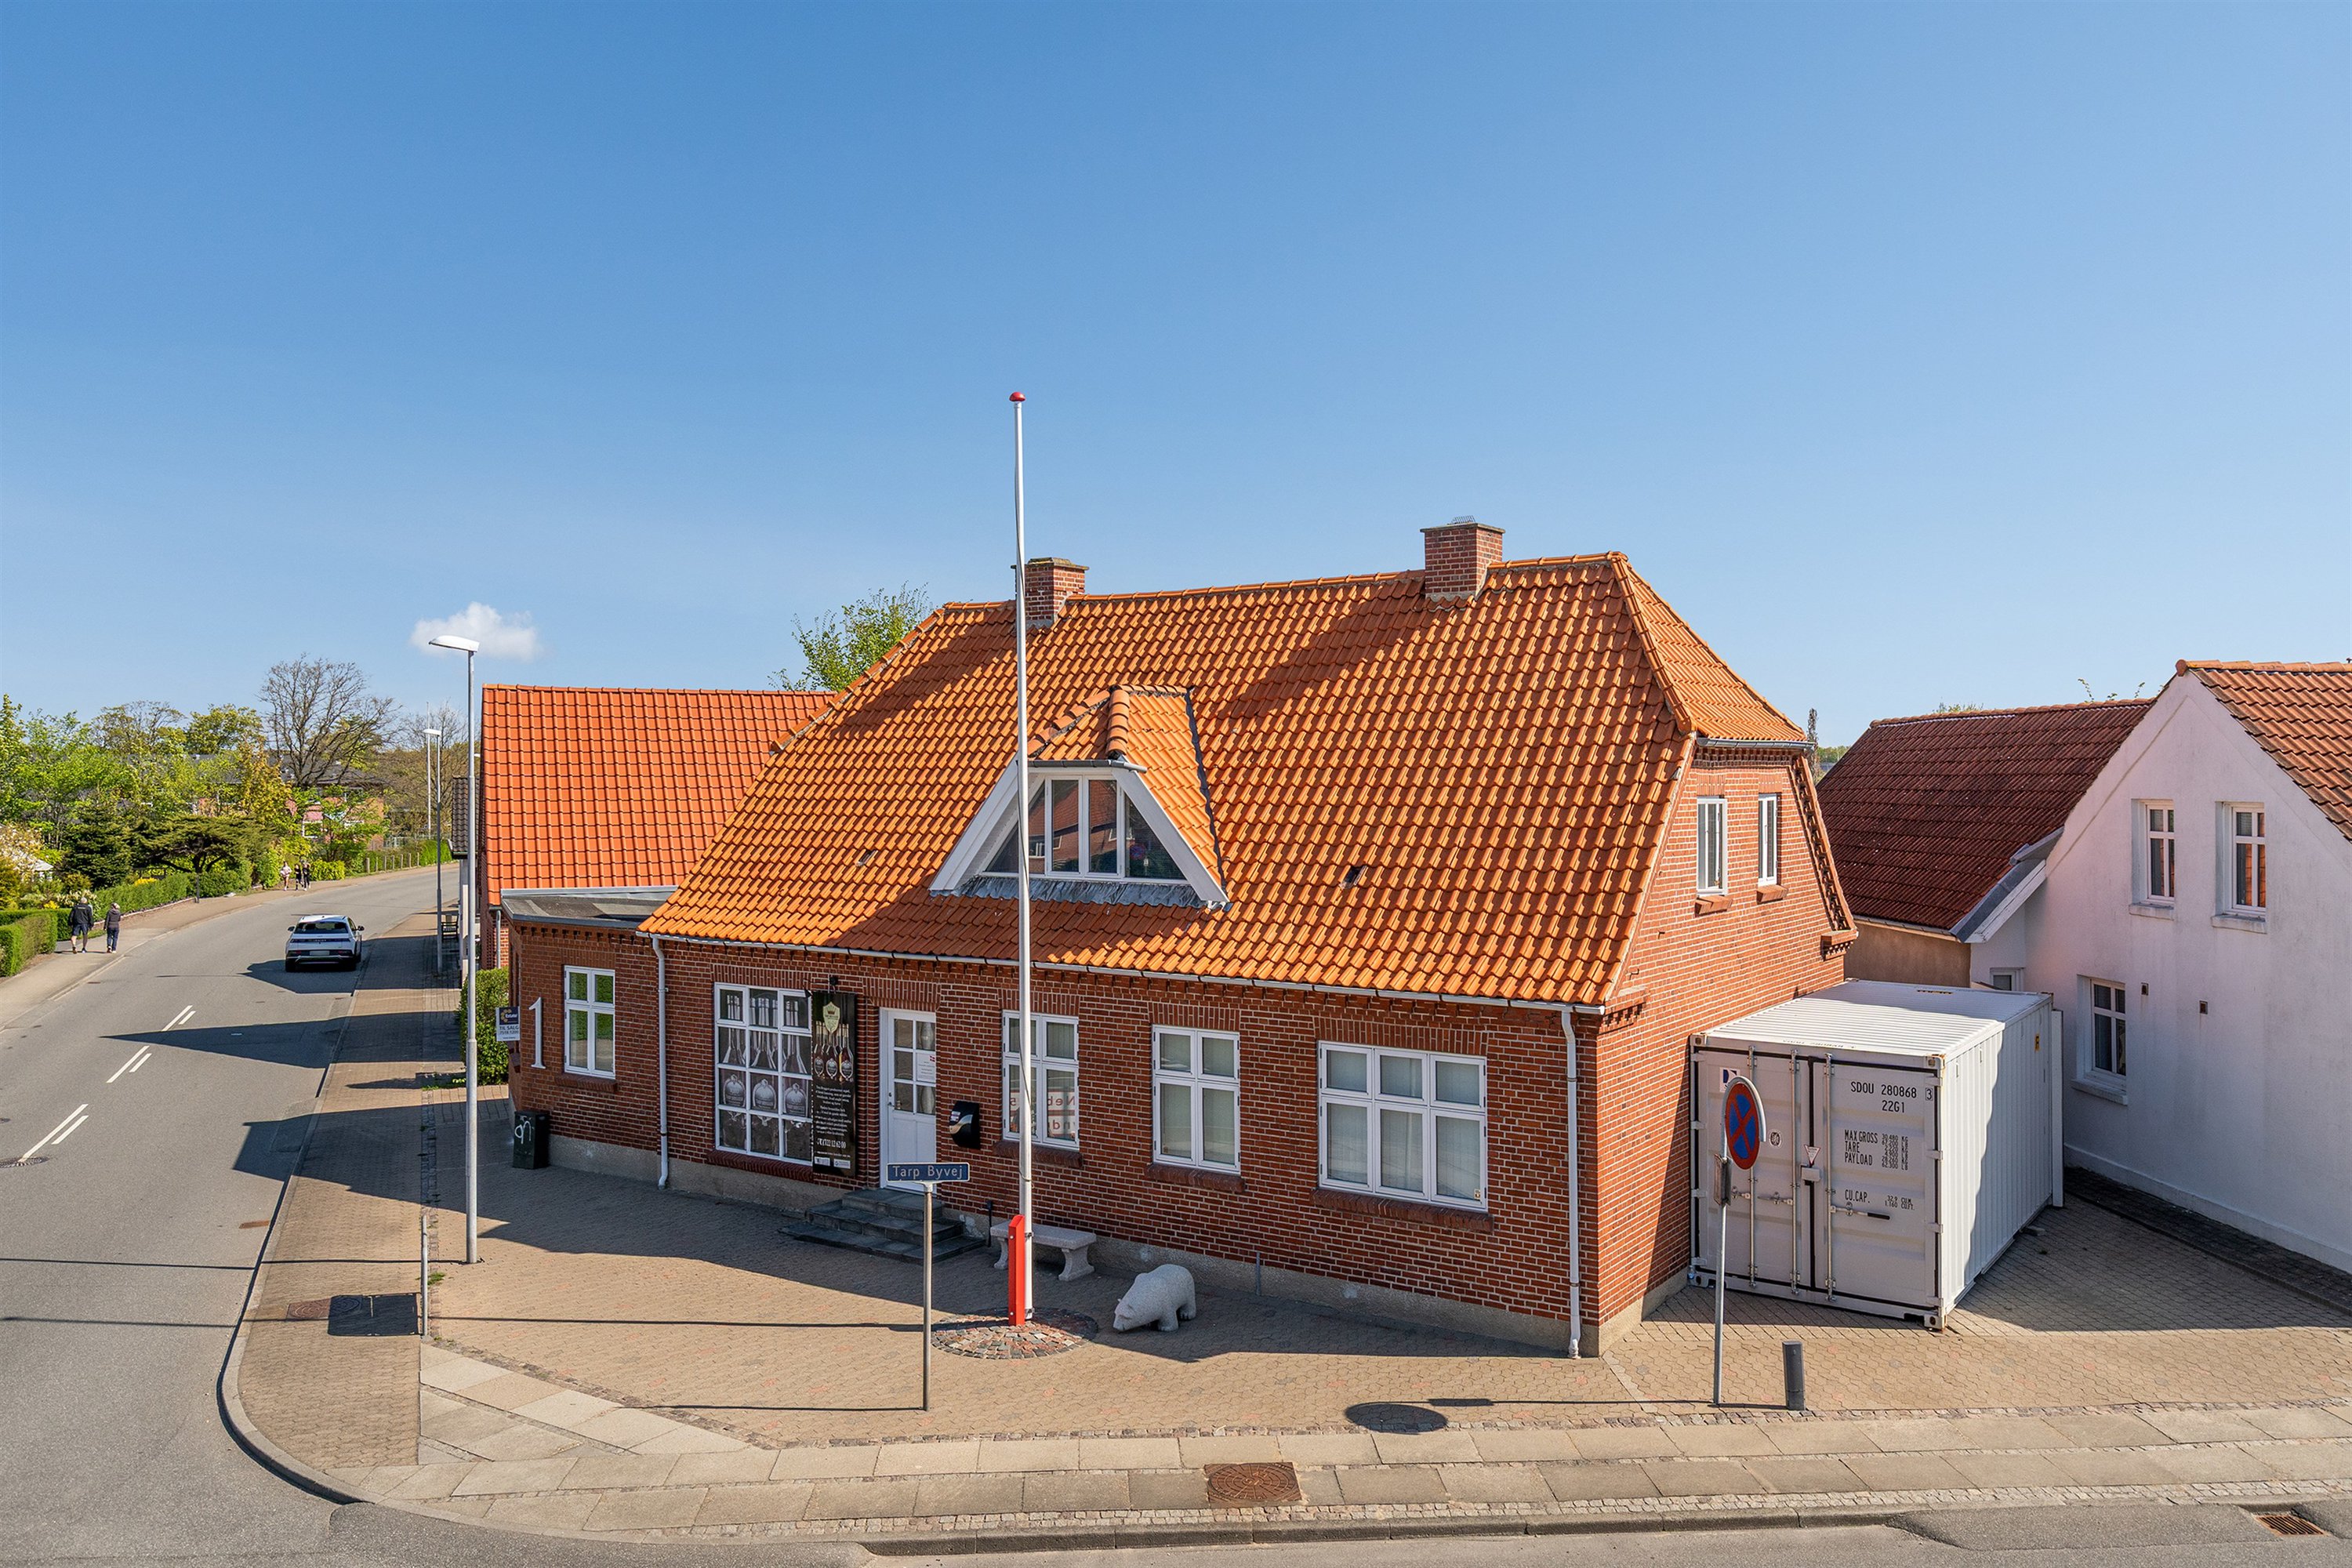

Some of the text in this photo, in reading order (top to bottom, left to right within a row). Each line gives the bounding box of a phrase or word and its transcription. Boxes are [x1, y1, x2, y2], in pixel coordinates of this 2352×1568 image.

[528, 996, 546, 1069] 1
[1850, 1080, 1933, 1101] SDOU 280868 3
[1882, 1099, 1905, 1113] 22G1
[1844, 1129, 1858, 1142] MAX
[1858, 1131, 1878, 1144] GROSS
[1845, 1141, 1860, 1153] TARE
[1844, 1152, 1873, 1166] PAYLOAD
[892, 1165, 963, 1180] Tarp Byvej
